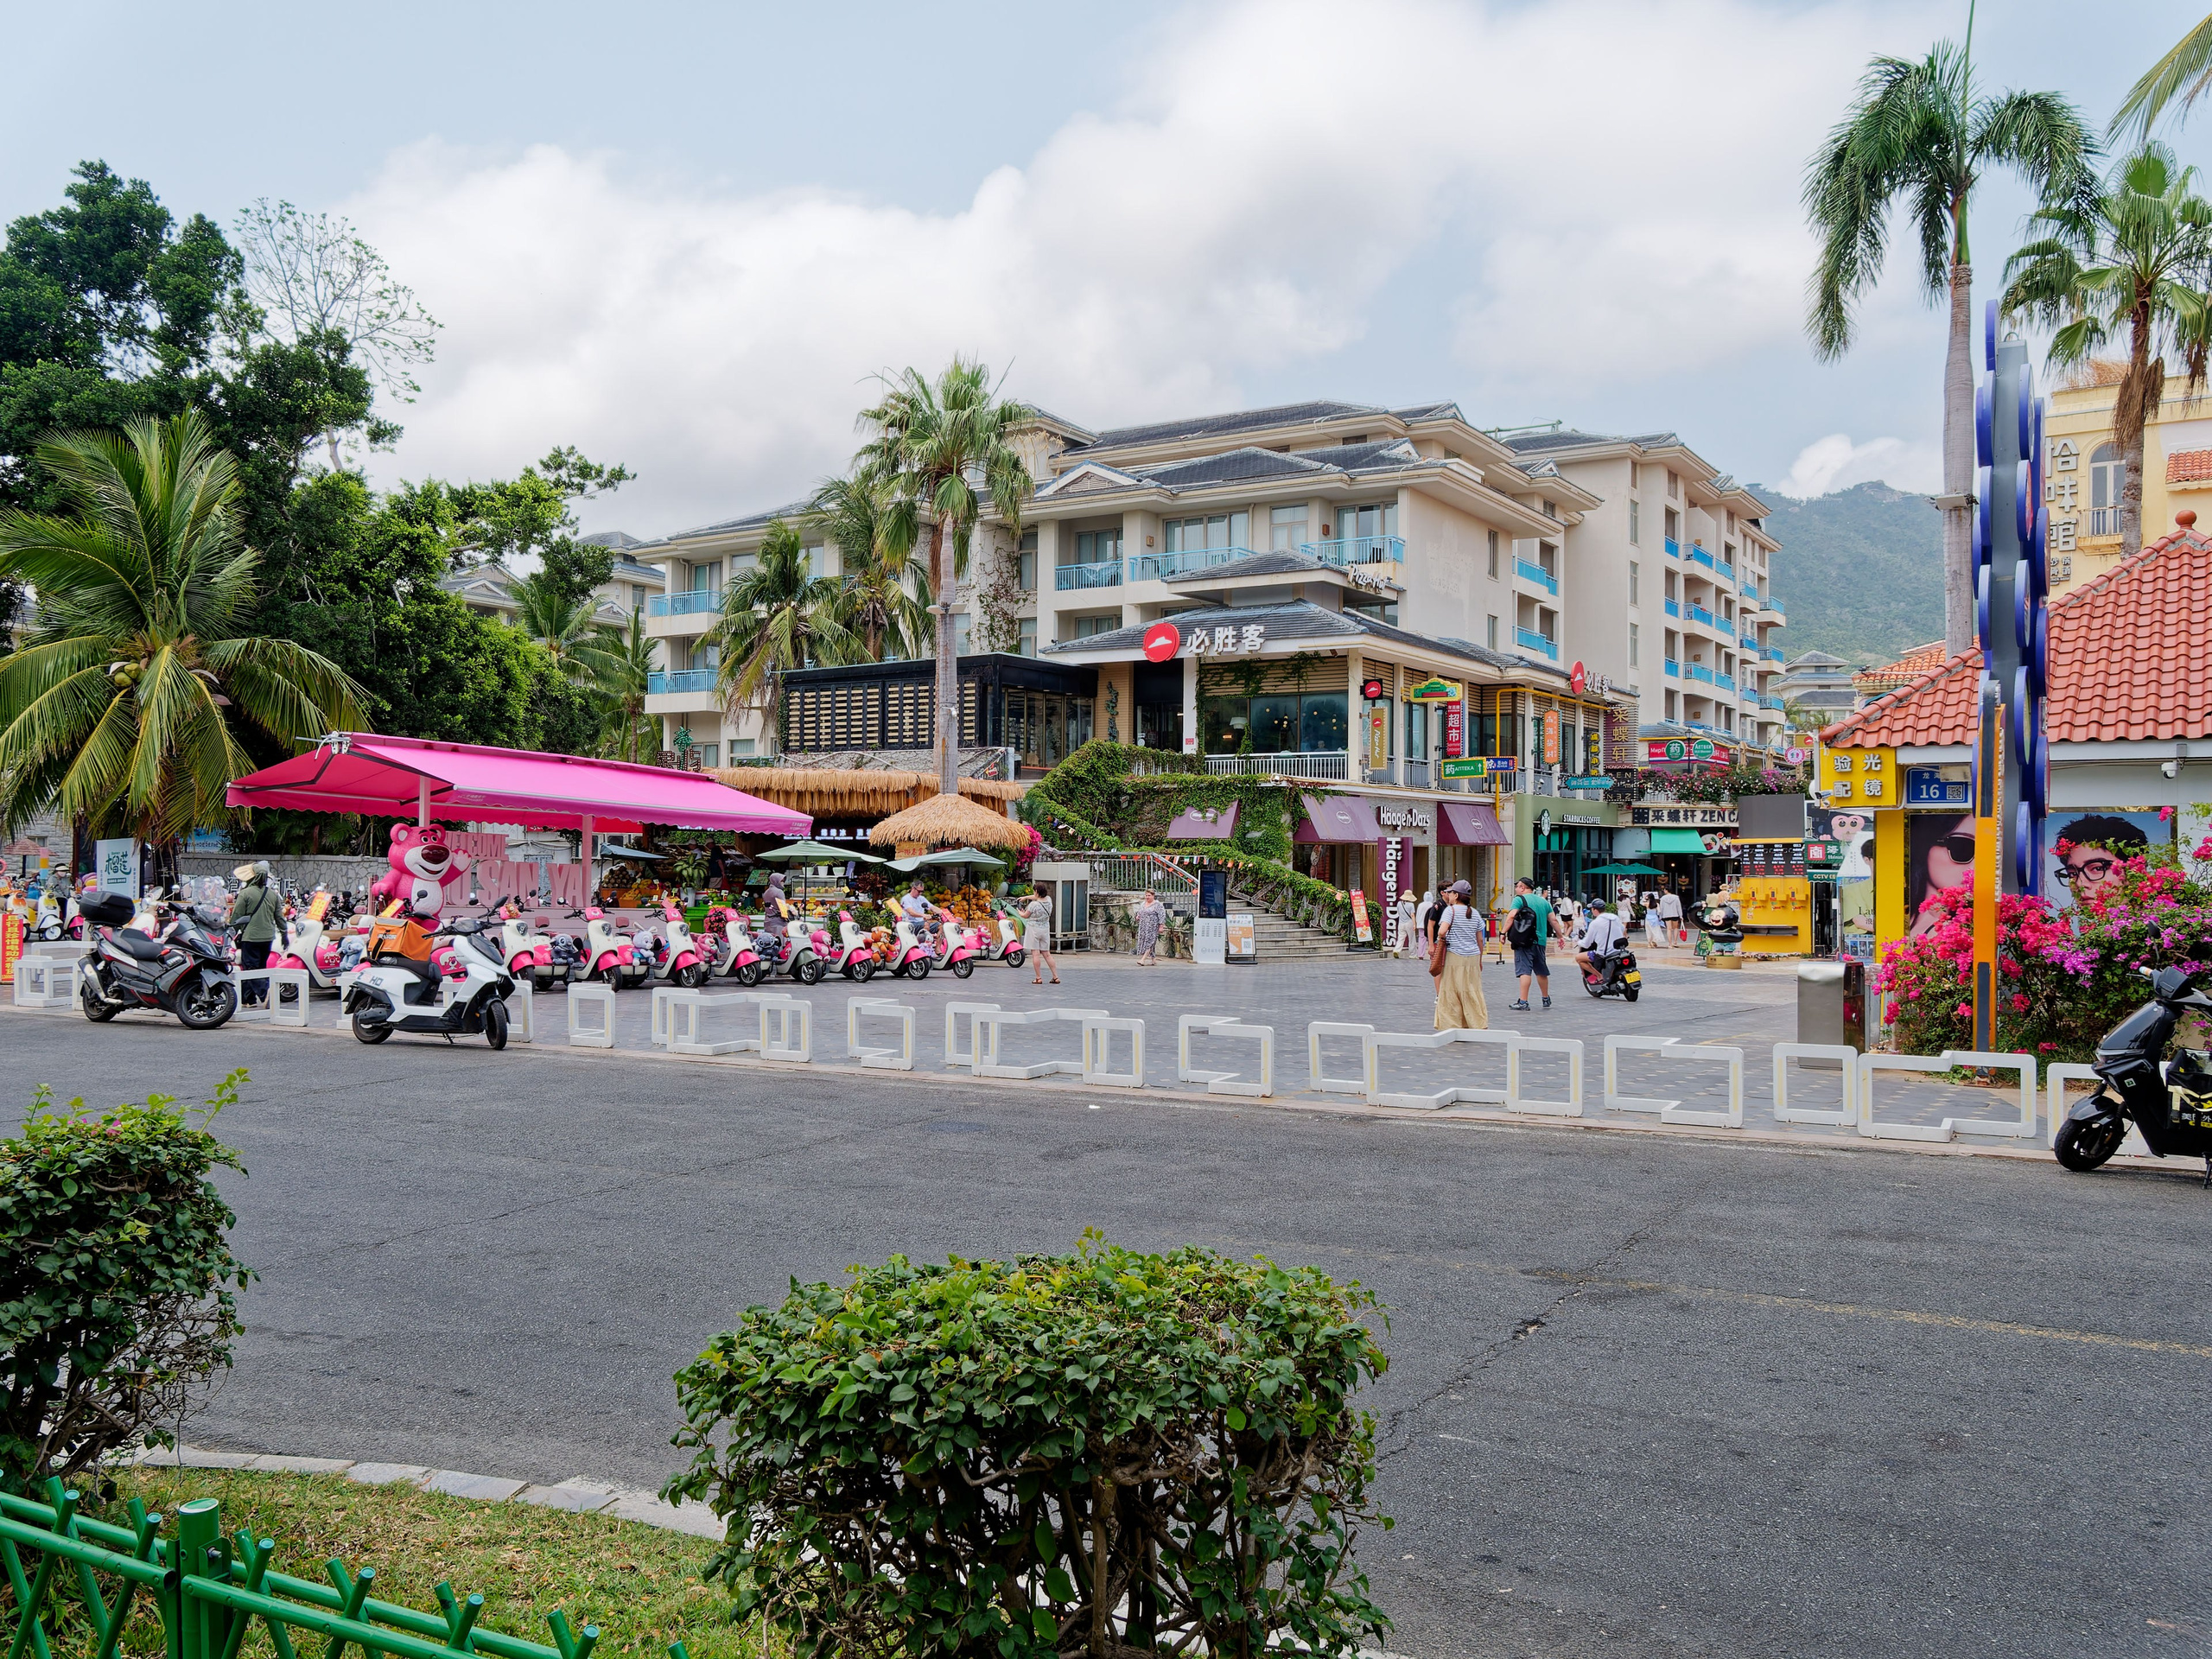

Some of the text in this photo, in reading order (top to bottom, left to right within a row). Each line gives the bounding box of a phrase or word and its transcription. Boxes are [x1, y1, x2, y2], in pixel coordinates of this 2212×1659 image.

[1349, 564, 1390, 592] Pizza Hut
[1186, 624, 1266, 653] 必胜客
[1448, 714, 1460, 742] 超市
[1670, 743, 1681, 753] 药
[1445, 764, 1455, 774] 药
[1834, 753, 1882, 772] 验光
[1834, 779, 1883, 798] 配镜
[1919, 784, 1940, 798] 16
[1380, 805, 1431, 830] Häagen-Dazs
[1563, 814, 1600, 824] STARBUCKS COFFEE
[1651, 809, 1697, 824] 采蝶轩
[1700, 810, 1726, 823] ZEN
[105, 851, 132, 875] 榴莲
[477, 860, 539, 907] SAN
[545, 863, 585, 907] YA
[1382, 836, 1403, 948] Häagen-Dazs
[357, 971, 385, 987] ZHO
